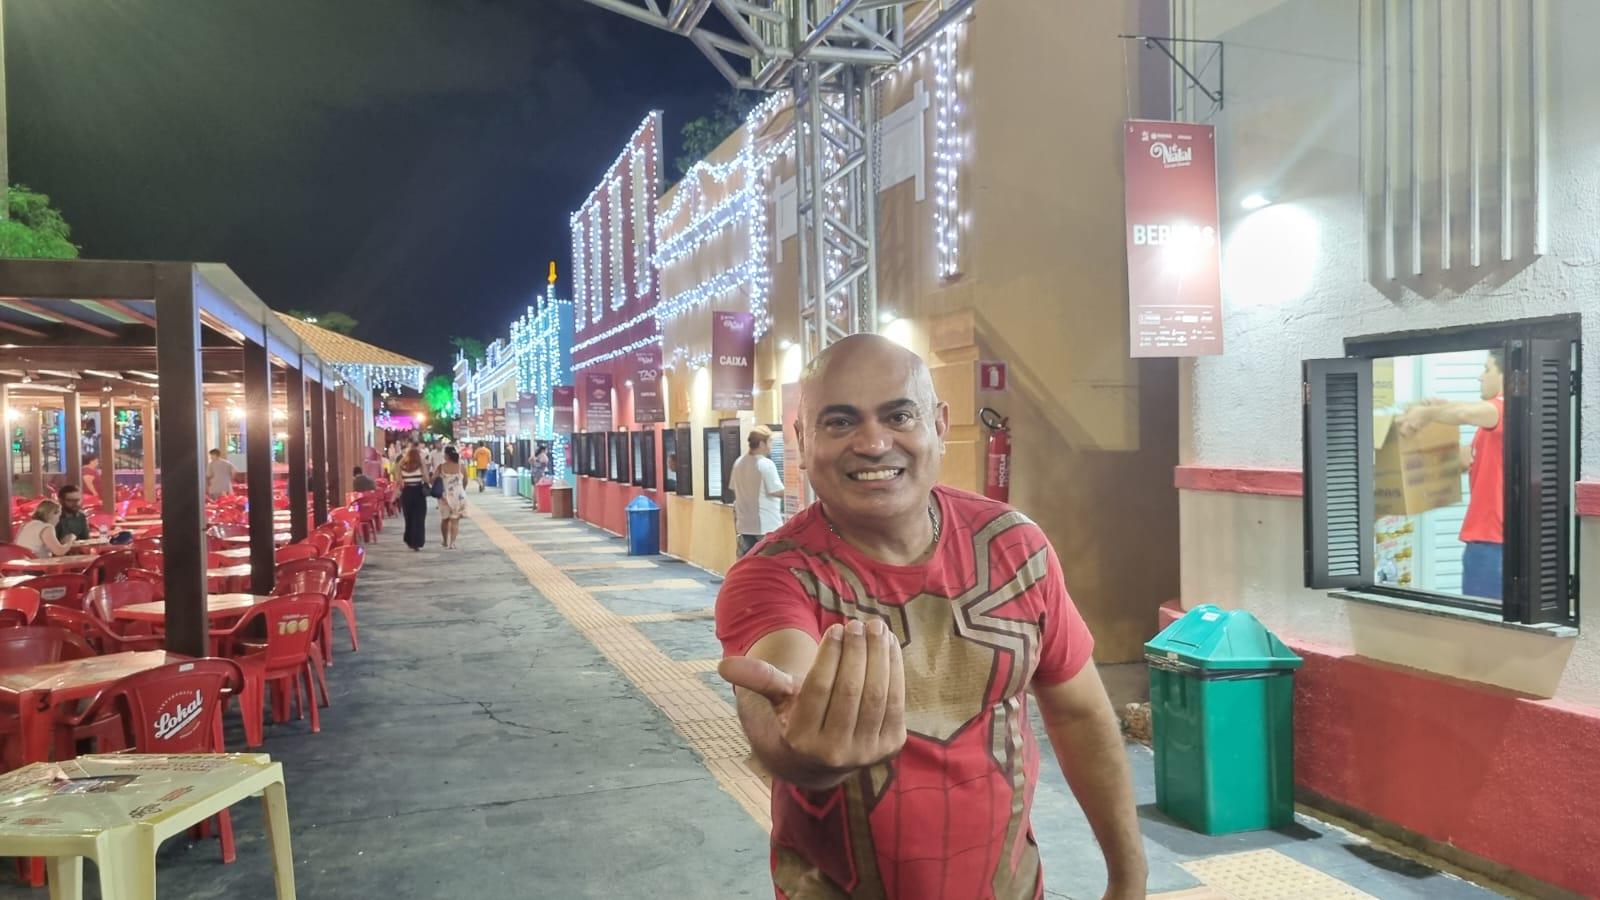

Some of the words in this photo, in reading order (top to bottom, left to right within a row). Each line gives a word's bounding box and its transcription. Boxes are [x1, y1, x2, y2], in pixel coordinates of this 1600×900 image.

[1149, 142, 1192, 163] Natal
[1133, 224, 1216, 246] BEBAS
[720, 356, 747, 366] CAIXA
[154, 689, 203, 738] Lokal
